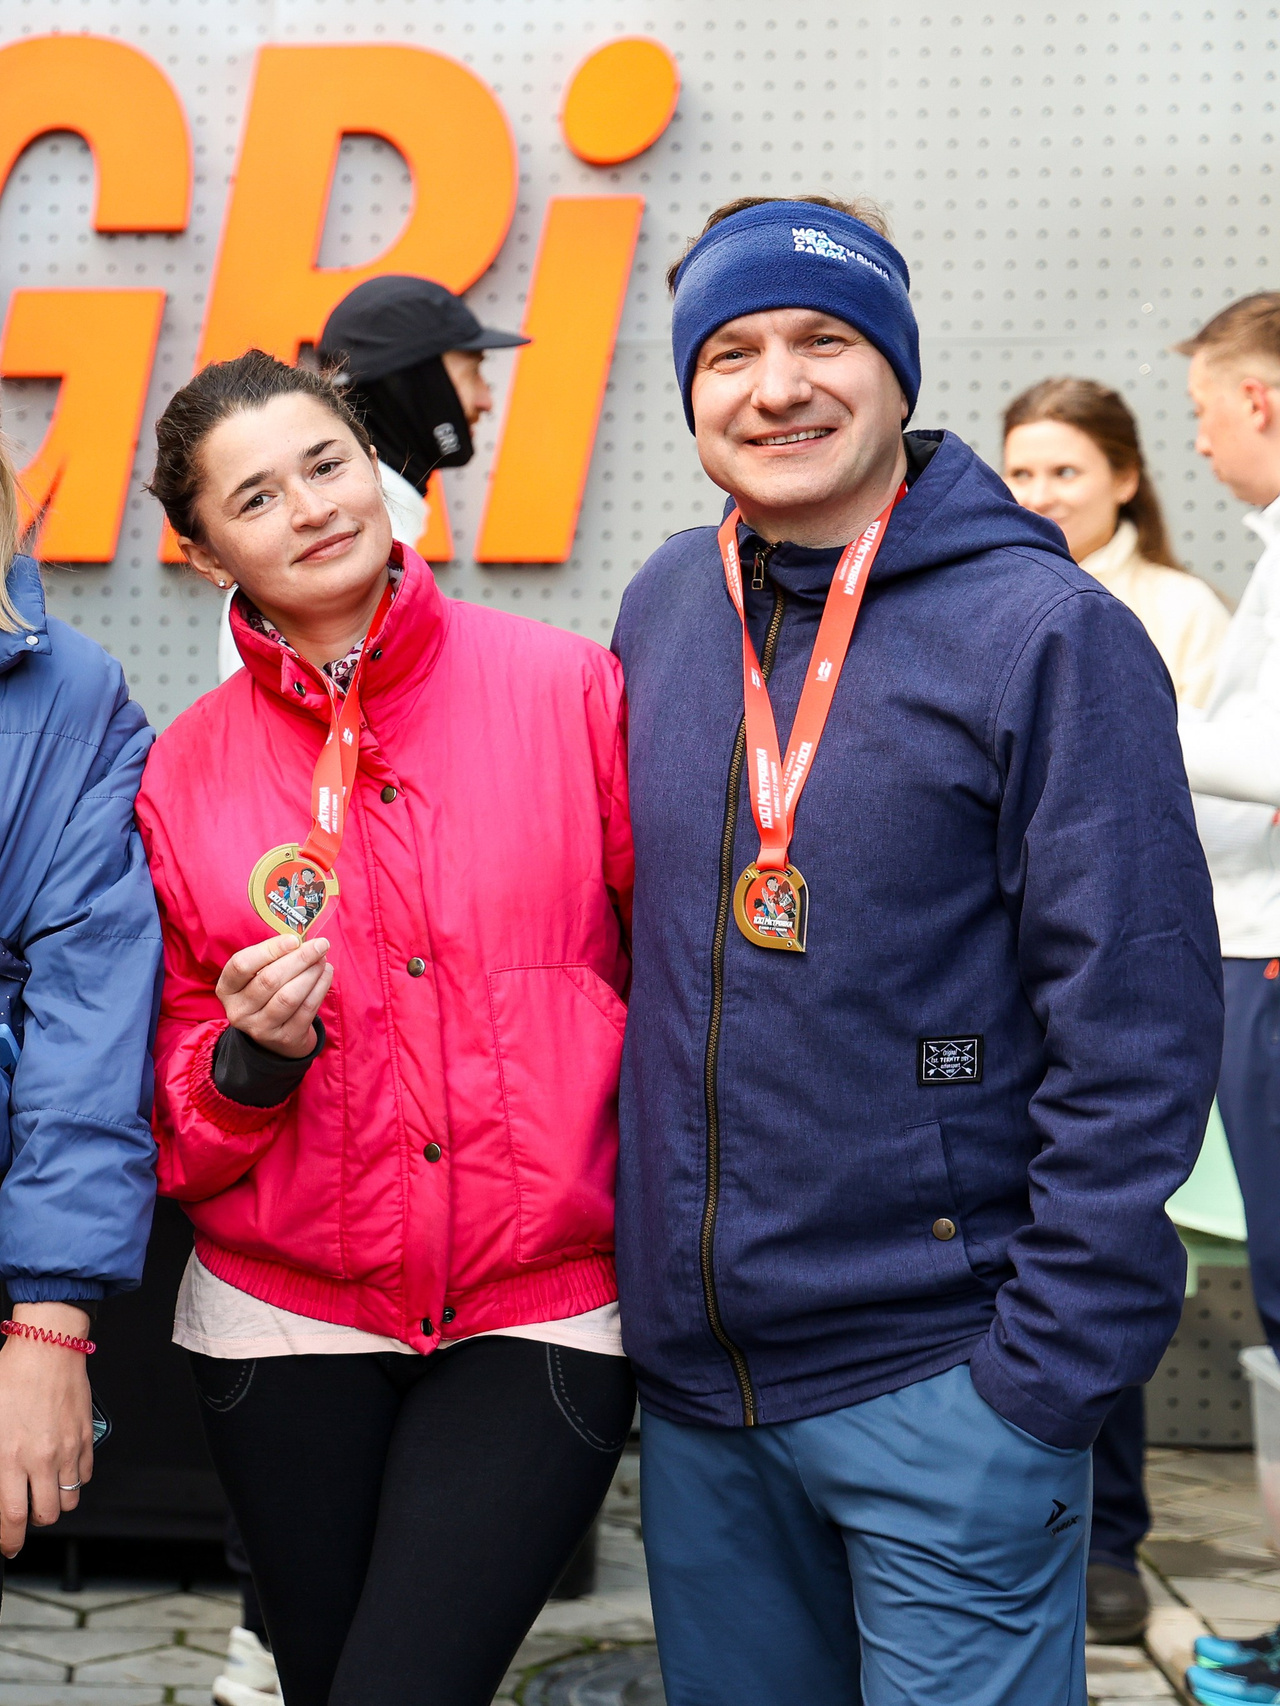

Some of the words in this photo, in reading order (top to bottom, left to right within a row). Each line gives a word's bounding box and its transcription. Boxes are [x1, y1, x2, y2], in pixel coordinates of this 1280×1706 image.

[843, 538, 874, 595] МЕТРОВКА
[796, 741, 812, 766] 100
[756, 748, 771, 807] МЕТРОВКА
[758, 805, 773, 829] 100
